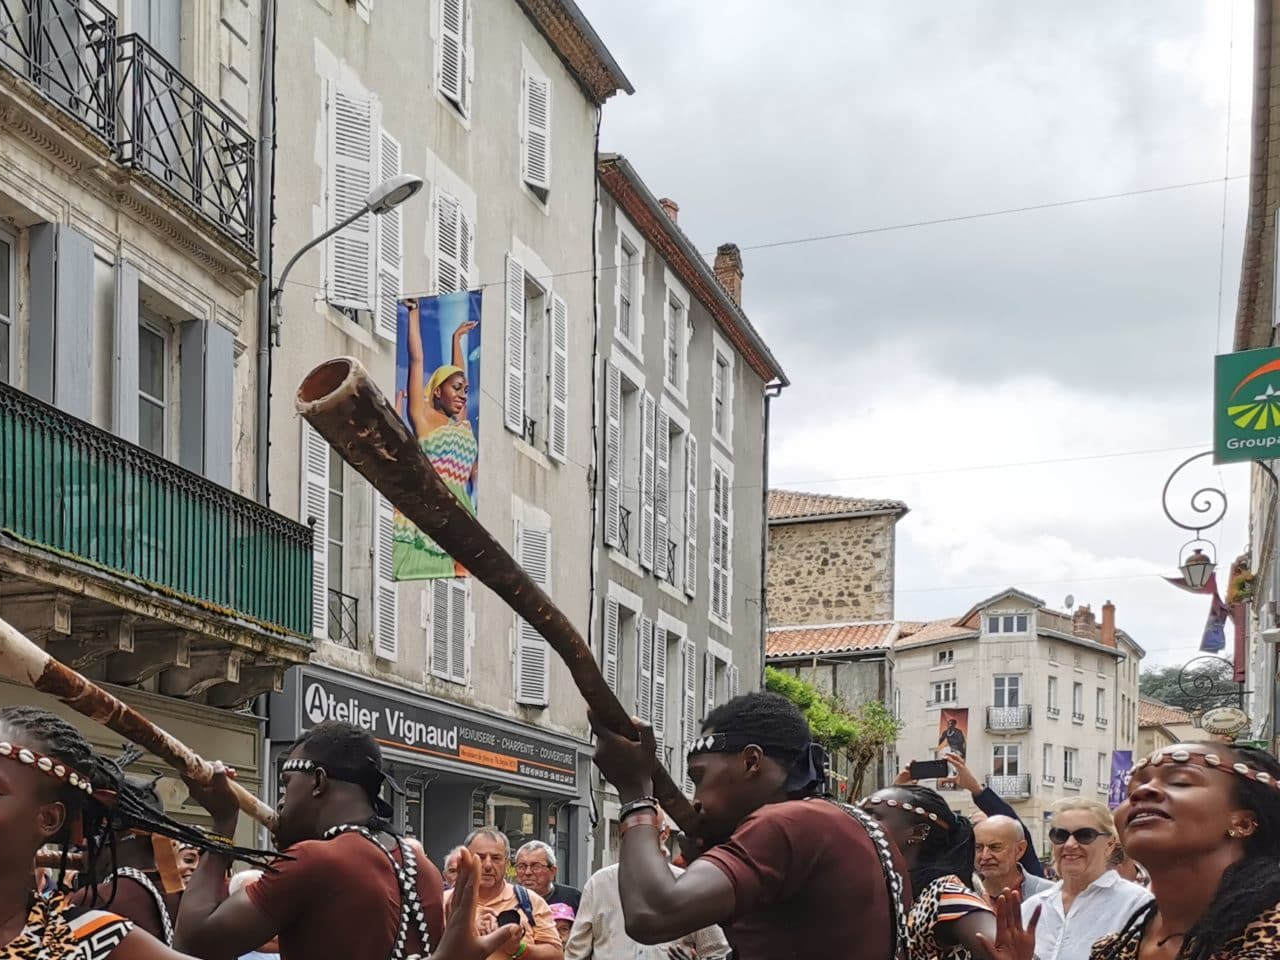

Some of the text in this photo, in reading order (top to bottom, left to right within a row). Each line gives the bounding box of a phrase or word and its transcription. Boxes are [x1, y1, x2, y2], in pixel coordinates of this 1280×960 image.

[305, 683, 458, 750] Atelier Vignaud
[459, 726, 496, 746] MENUISERIE
[501, 738, 535, 755] CHARPENTE
[540, 747, 573, 764] COUVERTURE
